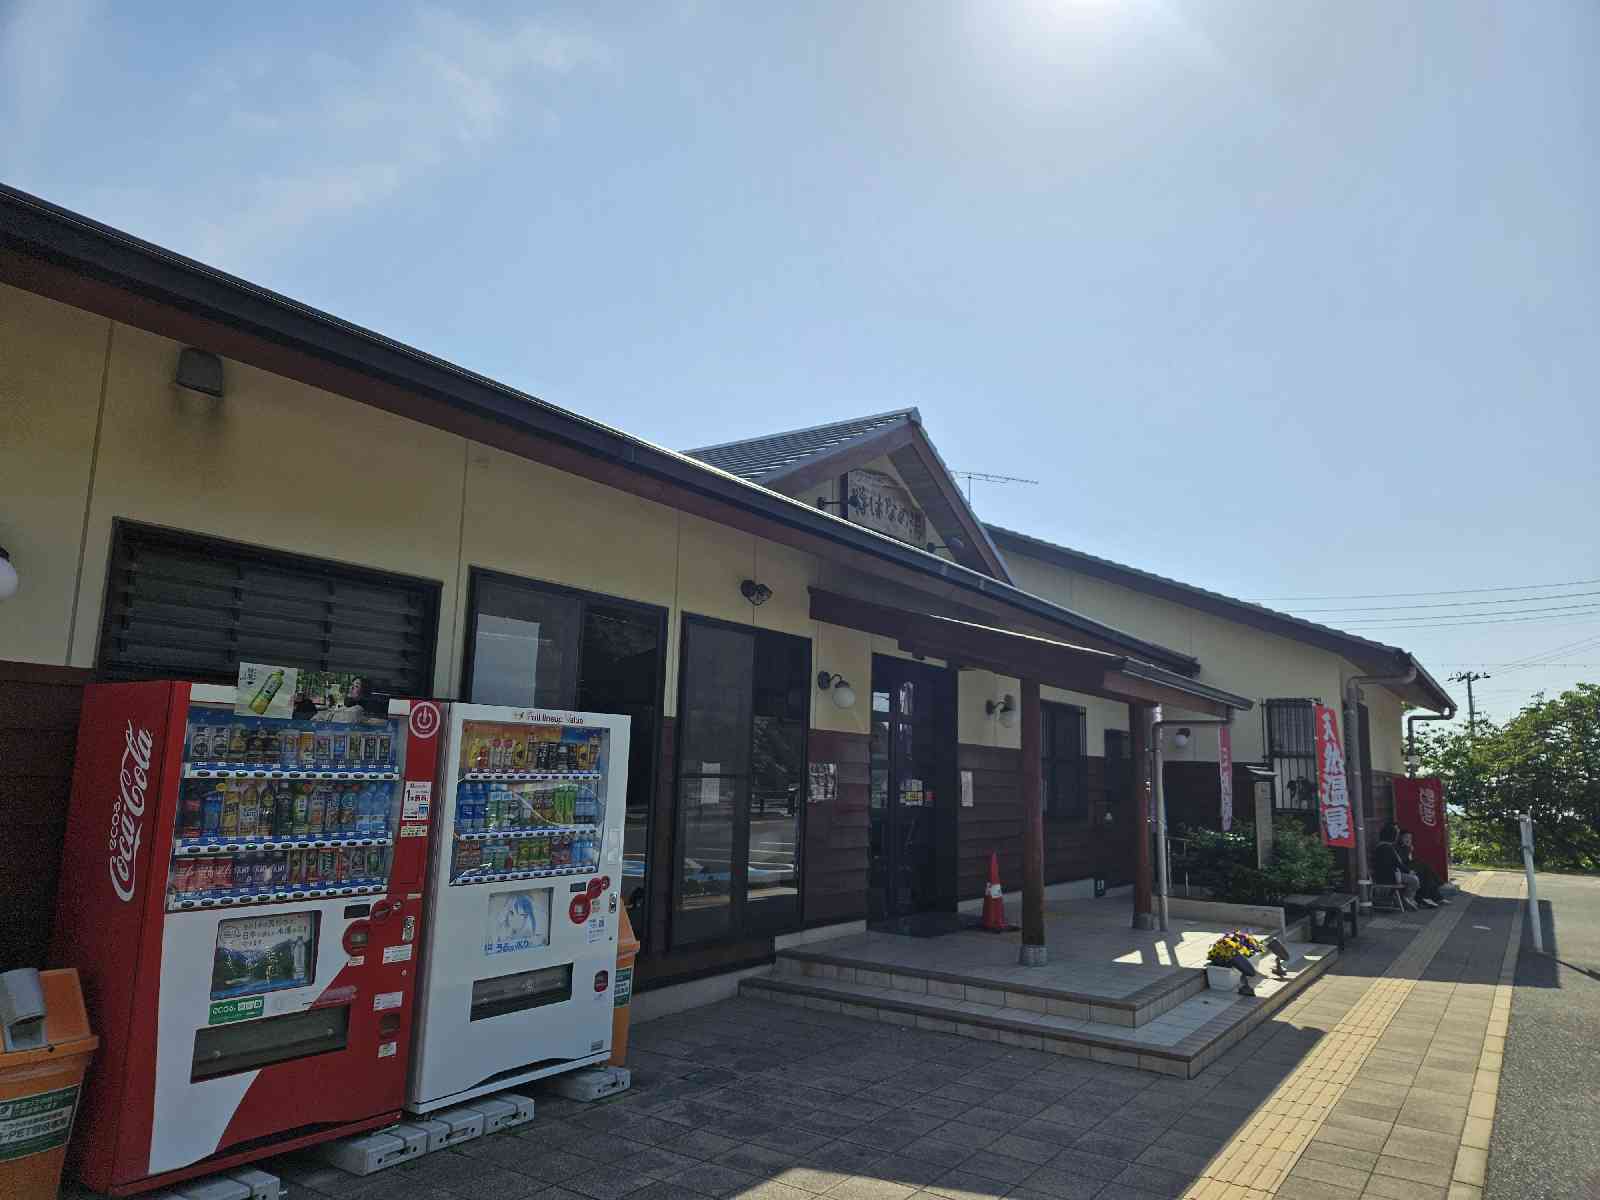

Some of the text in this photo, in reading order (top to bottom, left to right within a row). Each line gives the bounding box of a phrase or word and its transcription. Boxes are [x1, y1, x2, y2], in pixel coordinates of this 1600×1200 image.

[110, 719, 154, 902] Coca-Cola
[1321, 711, 1350, 839] 天然温泉
